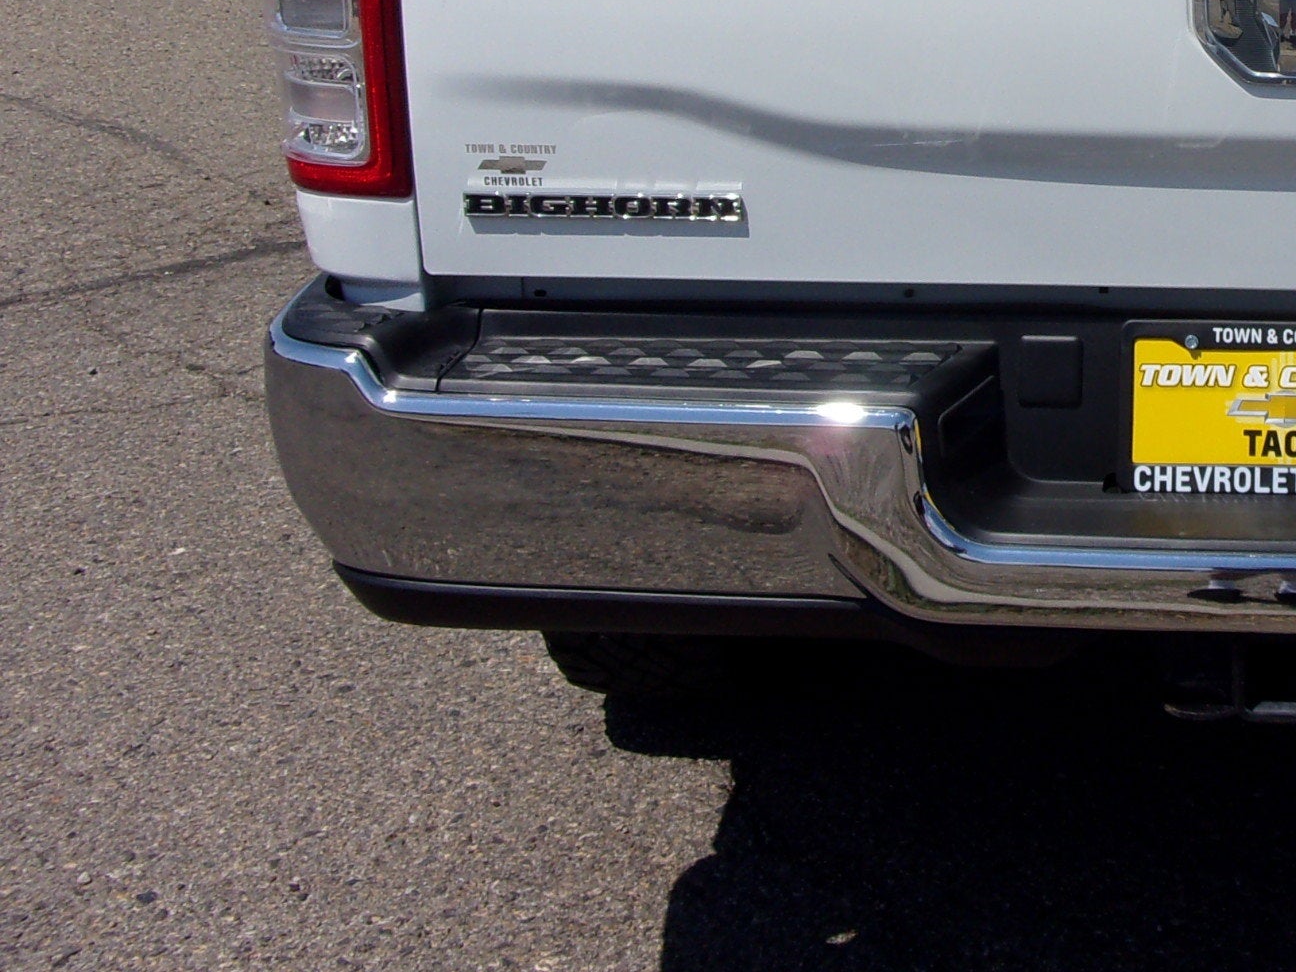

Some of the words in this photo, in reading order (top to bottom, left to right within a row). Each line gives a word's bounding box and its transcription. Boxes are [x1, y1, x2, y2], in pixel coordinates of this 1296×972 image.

[465, 143, 495, 154] TOWN
[499, 144, 507, 154] &
[510, 144, 557, 155] COUNTRY
[484, 176, 544, 187] CHEVROLET
[1213, 327, 1264, 344] TOWN
[1267, 329, 1279, 344] &
[1139, 363, 1237, 388] TOWN
[1243, 365, 1270, 389] &
